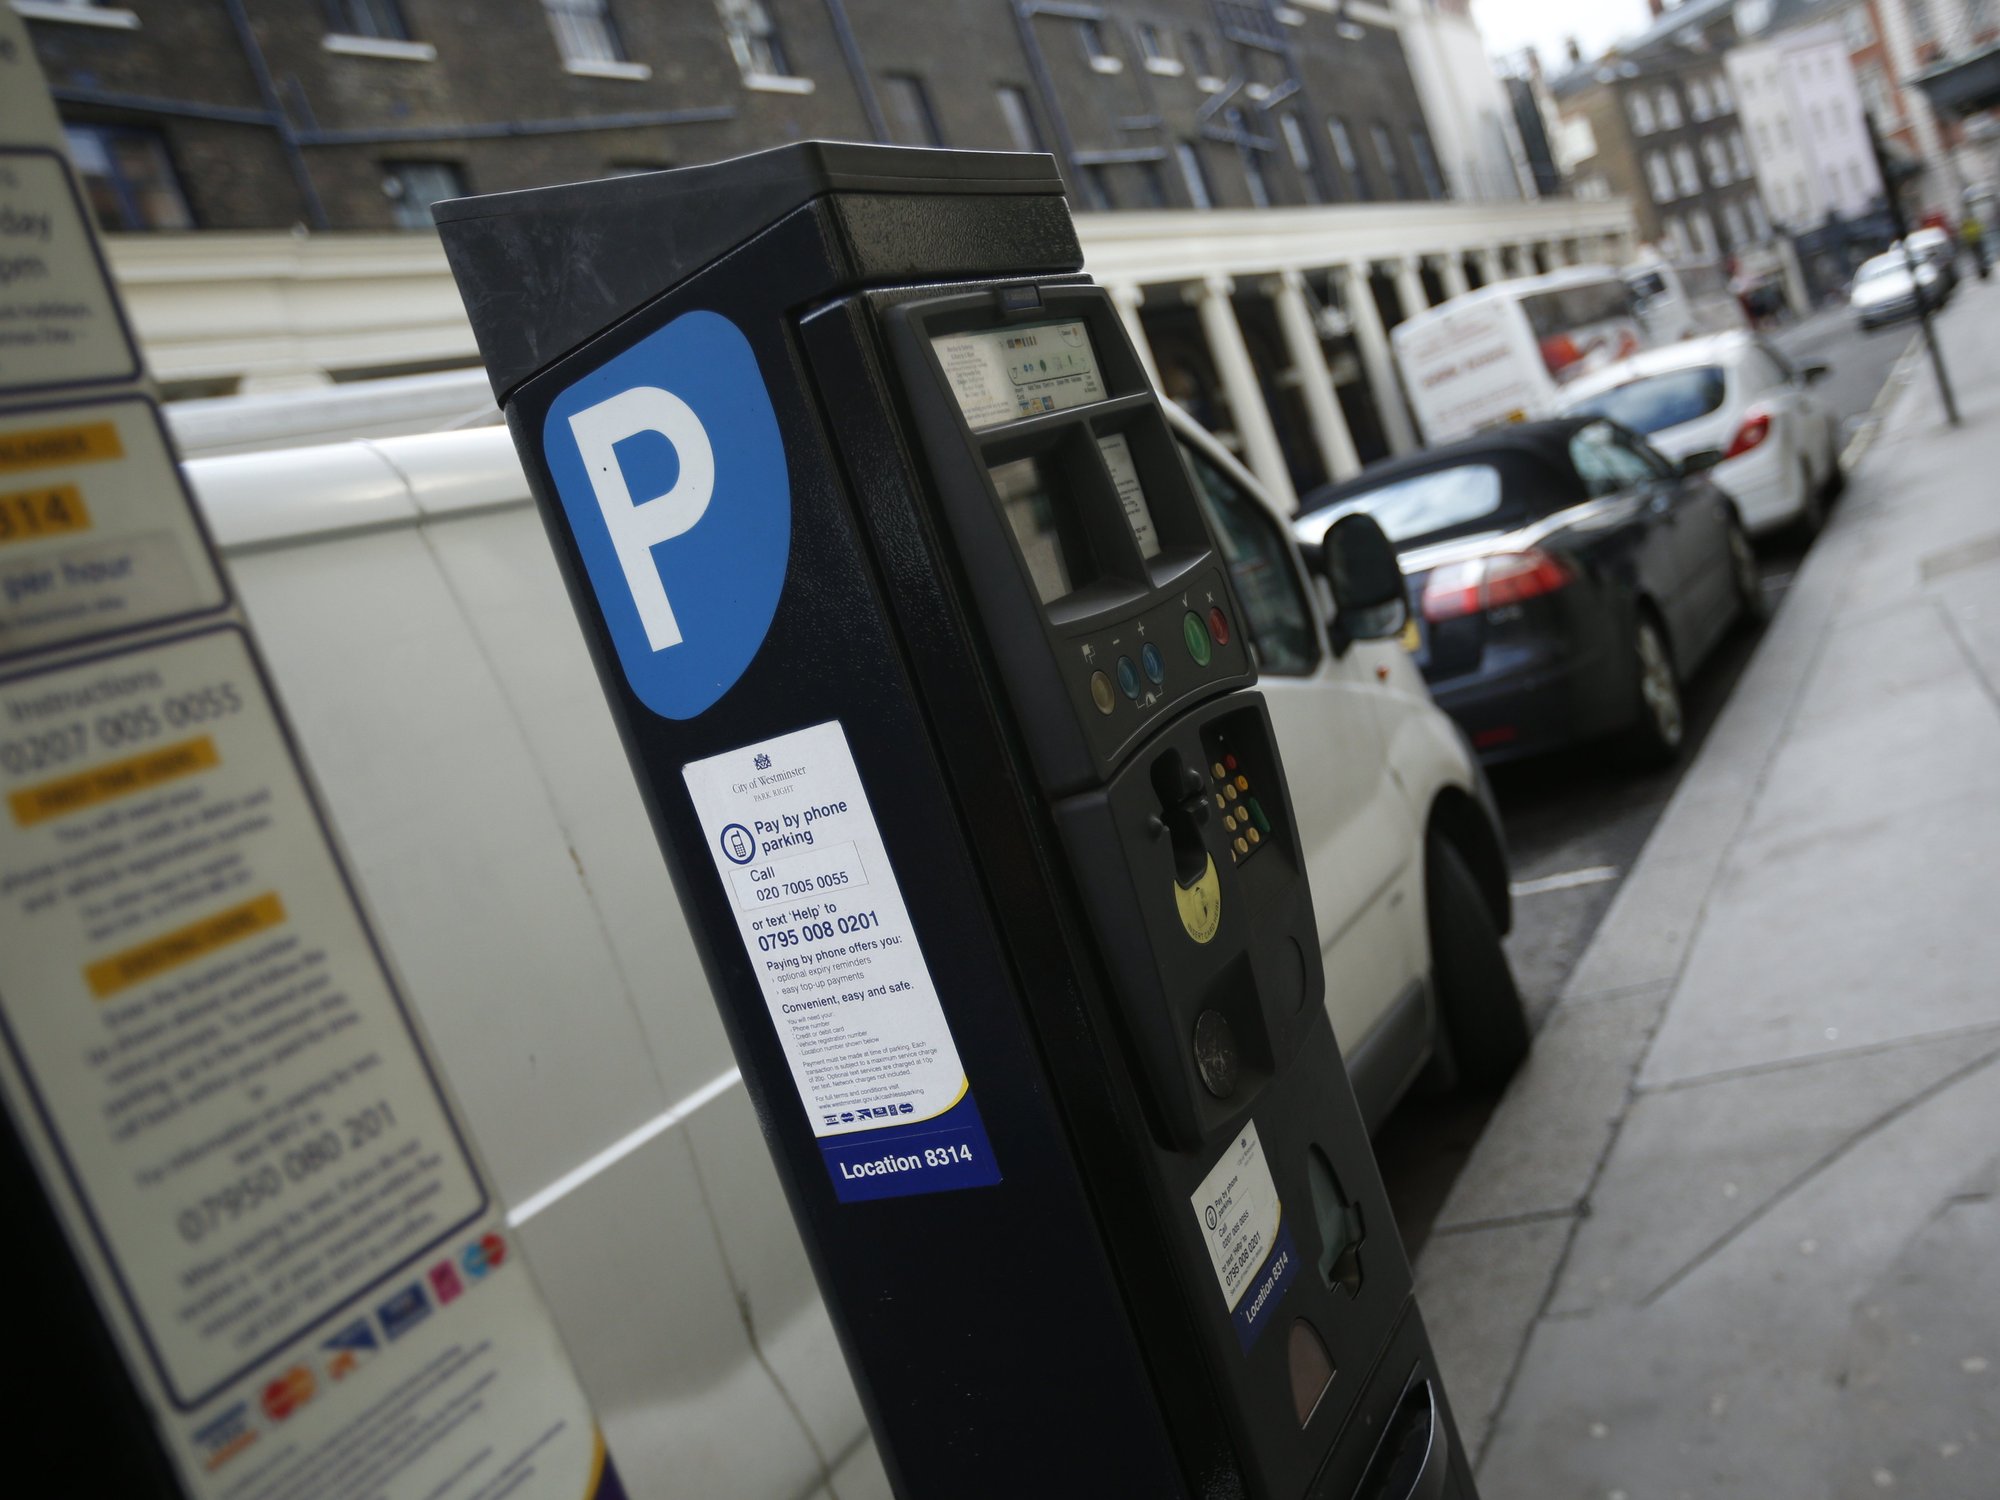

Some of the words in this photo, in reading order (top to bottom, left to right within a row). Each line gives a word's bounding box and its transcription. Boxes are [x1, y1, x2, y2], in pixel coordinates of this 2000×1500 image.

[568, 386, 715, 652] P
[732, 783, 748, 794] City
[750, 778, 757, 790] of
[758, 766, 806, 786] Westminster
[753, 791, 771, 802] PARK
[773, 785, 794, 796] RIGHT
[754, 820, 779, 834] Pay
[782, 814, 799, 828] by
[804, 801, 848, 825] phone
[762, 830, 814, 856] parking
[750, 866, 775, 882] Call
[756, 886, 780, 901] 020
[782, 879, 814, 895] 7005
[816, 872, 848, 888] 0055
[752, 920, 764, 930] or
[766, 913, 788, 927] text
[824, 903, 836, 914] to
[758, 929, 799, 952] 0795
[802, 921, 834, 942] 008
[838, 910, 879, 934] 0201
[766, 957, 799, 971] Paying
[801, 954, 812, 964] by
[816, 946, 846, 961] phone
[848, 941, 878, 954] offers
[880, 935, 902, 949] you:
[777, 969, 807, 982] optional
[808, 965, 831, 976] expiry
[832, 956, 872, 971] reminders
[782, 986, 799, 995] easy
[800, 980, 825, 991] top-up
[827, 972, 864, 987] payments
[782, 996, 840, 1014] Convenient,
[842, 991, 864, 1002] easy
[868, 985, 886, 997] and
[888, 980, 914, 993] safe.
[810, 1021, 830, 1029] number
[346, 1100, 398, 1147] 201
[840, 1155, 922, 1180] Location
[924, 1144, 972, 1167] 8314
[1226, 1263, 1239, 1286] 0795
[1248, 1231, 1260, 1252] 0201
[1246, 1276, 1274, 1323] Location
[1273, 1251, 1288, 1280] 8314
